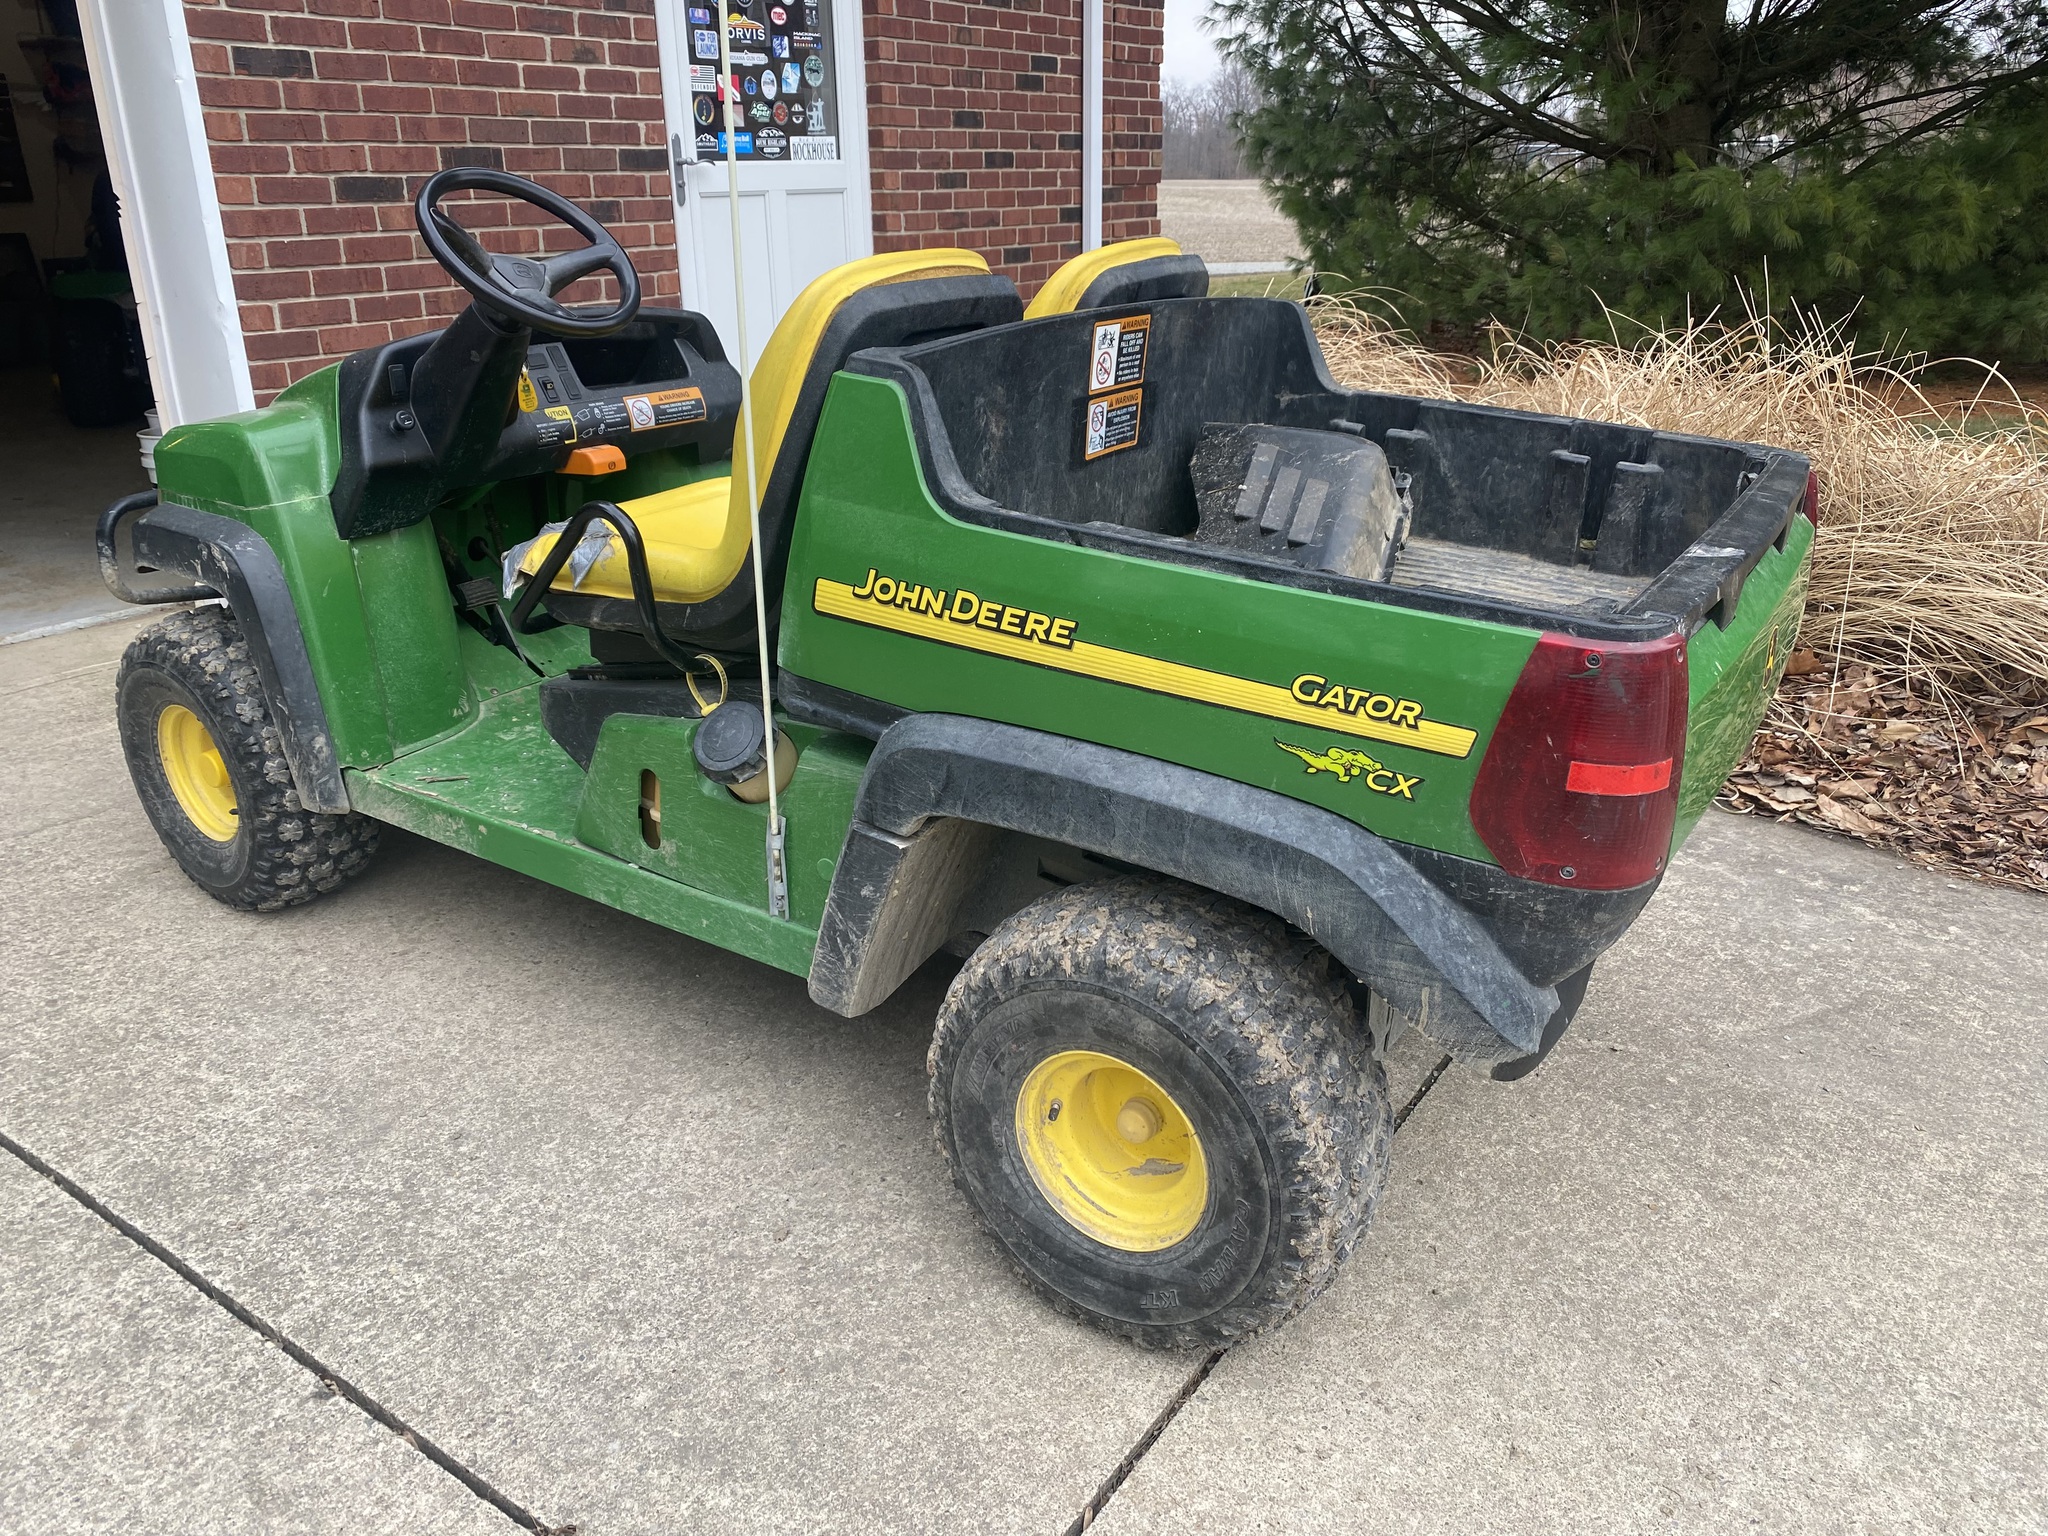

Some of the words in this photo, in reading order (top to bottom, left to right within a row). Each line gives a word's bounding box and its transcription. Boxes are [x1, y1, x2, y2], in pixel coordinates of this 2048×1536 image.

[707, 33, 716, 43] FOR
[728, 28, 766, 40] ORVIS
[697, 43, 717, 55] LAUNCH
[792, 143, 835, 160] ROCKHOUSE
[1126, 318, 1149, 329] WARNING
[664, 391, 690, 400] WARNING
[1115, 393, 1138, 406] WARNING
[548, 409, 568, 418] UTION
[852, 568, 947, 617] JOHN
[949, 588, 1079, 650] DEERE
[1290, 673, 1424, 730] GATOR
[1364, 769, 1426, 802] CX
